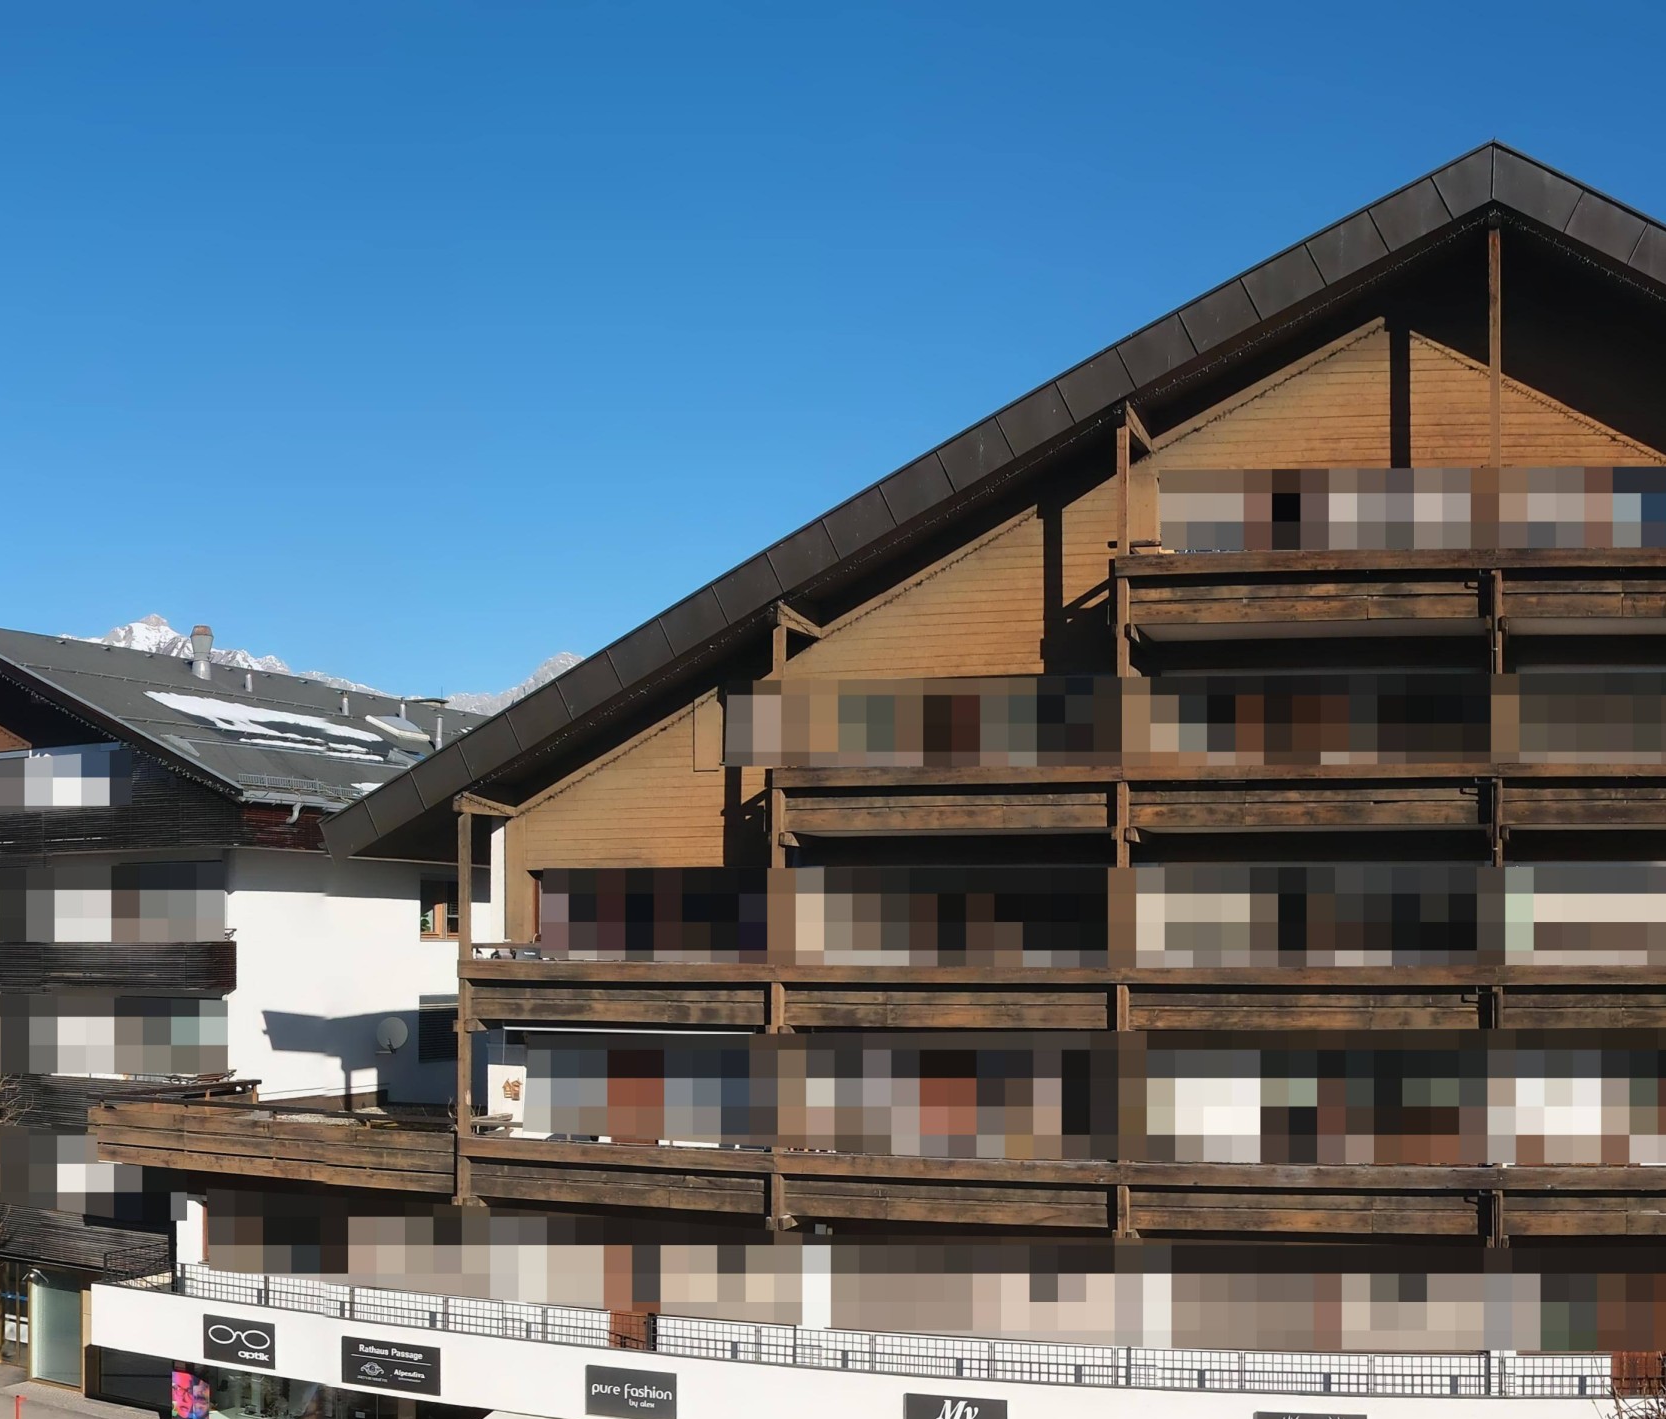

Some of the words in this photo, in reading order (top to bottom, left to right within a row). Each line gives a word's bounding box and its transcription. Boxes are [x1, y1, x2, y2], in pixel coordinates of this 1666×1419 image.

[237, 1350, 270, 1362] optik
[358, 1343, 389, 1356] Rathaus
[391, 1348, 423, 1361] Passage
[591, 1383, 621, 1396] pure
[624, 1383, 673, 1401] fashion
[628, 1399, 638, 1408] by
[639, 1400, 655, 1408] alex
